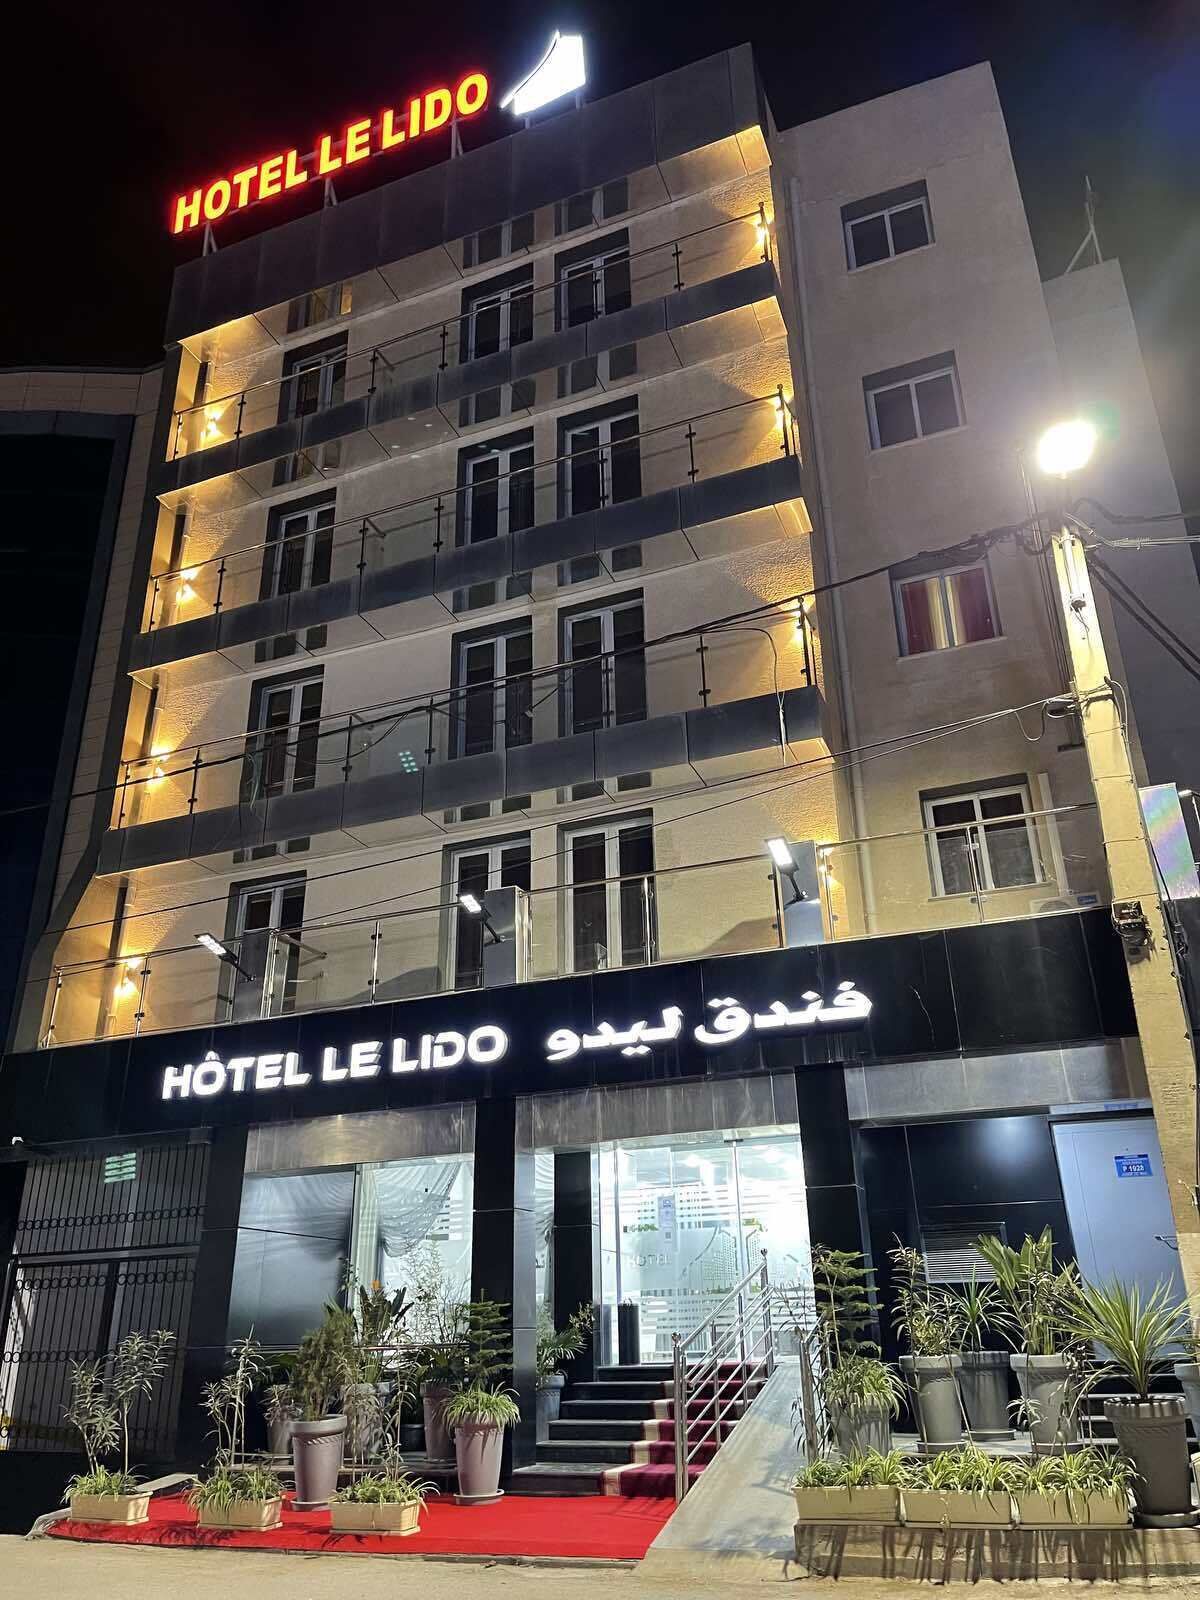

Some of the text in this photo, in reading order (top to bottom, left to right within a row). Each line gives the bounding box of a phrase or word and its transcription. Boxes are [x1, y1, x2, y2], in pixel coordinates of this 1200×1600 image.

[173, 73, 489, 234] HOTEL LE LIDO
[545, 980, 874, 1061] فندق ليدو
[161, 1024, 509, 1100] HÔTEL LE LIDO
